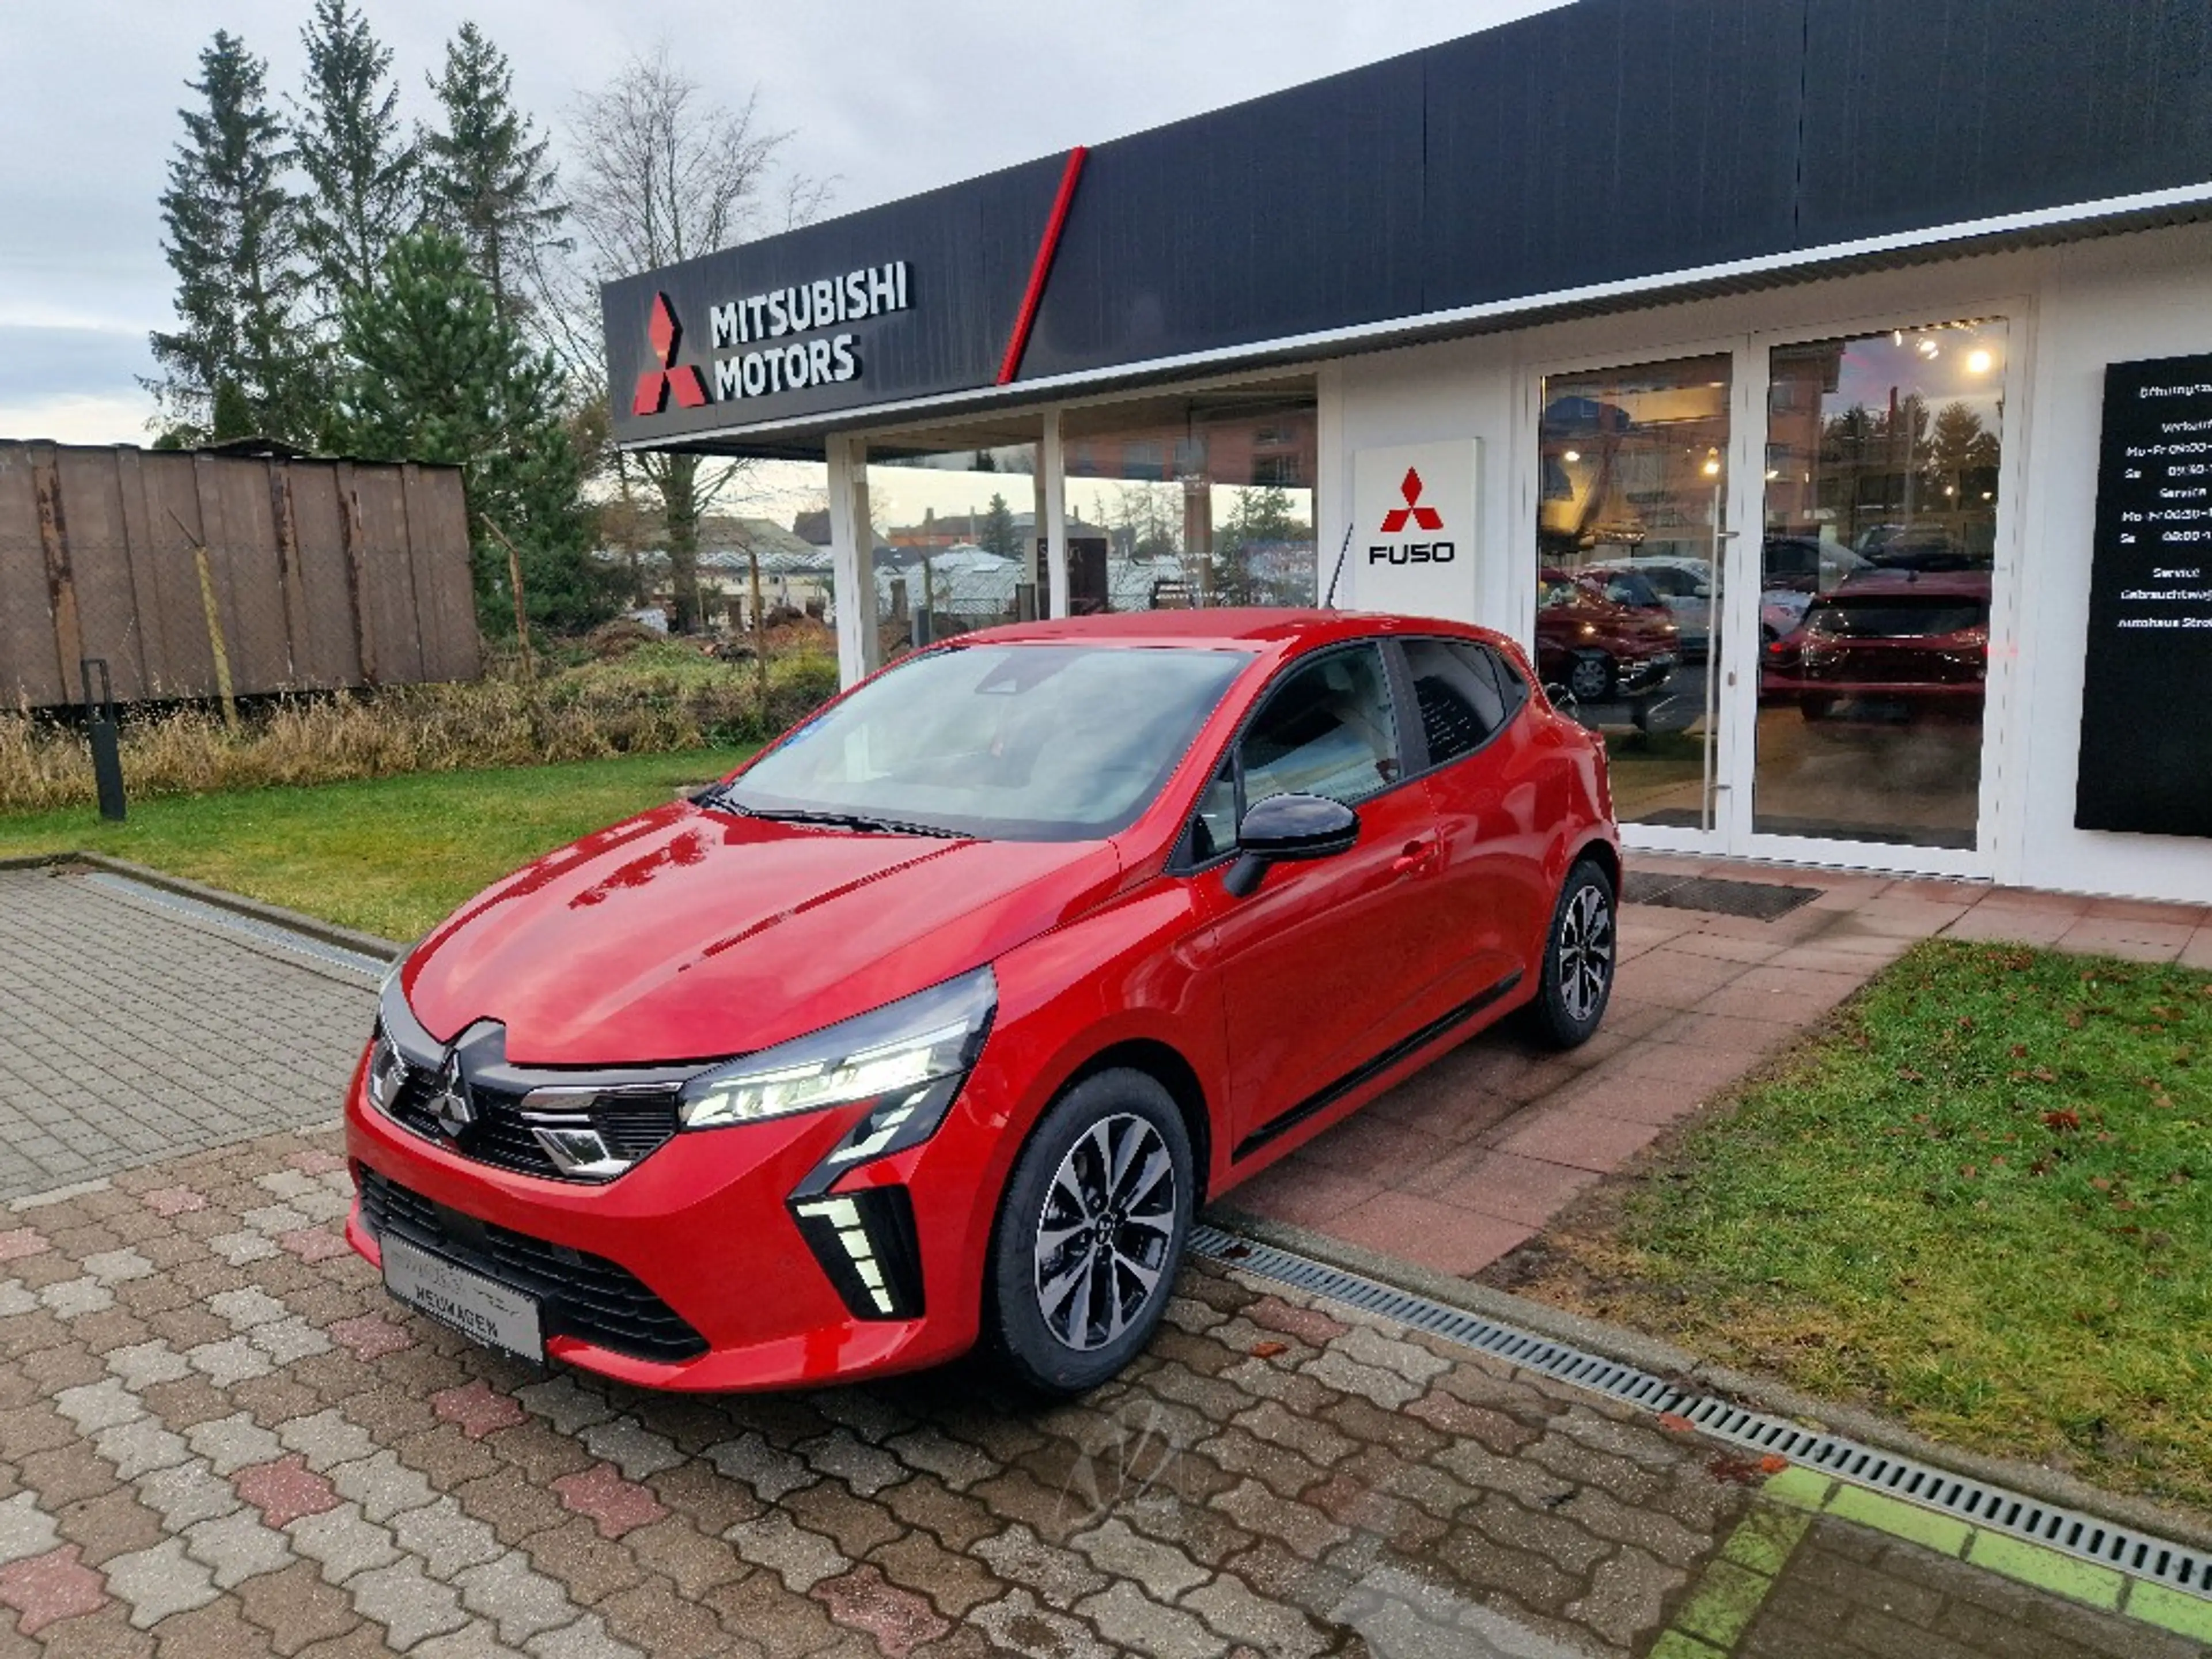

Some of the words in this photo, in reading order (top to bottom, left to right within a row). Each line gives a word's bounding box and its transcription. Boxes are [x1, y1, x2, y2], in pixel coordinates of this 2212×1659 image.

[710, 261, 906, 348] MITSUBISHI
[715, 334, 854, 400] MOTORS
[1369, 542, 1455, 565] FUSO
[2153, 567, 2200, 578] Service
[2117, 617, 2180, 628] Autohaus
